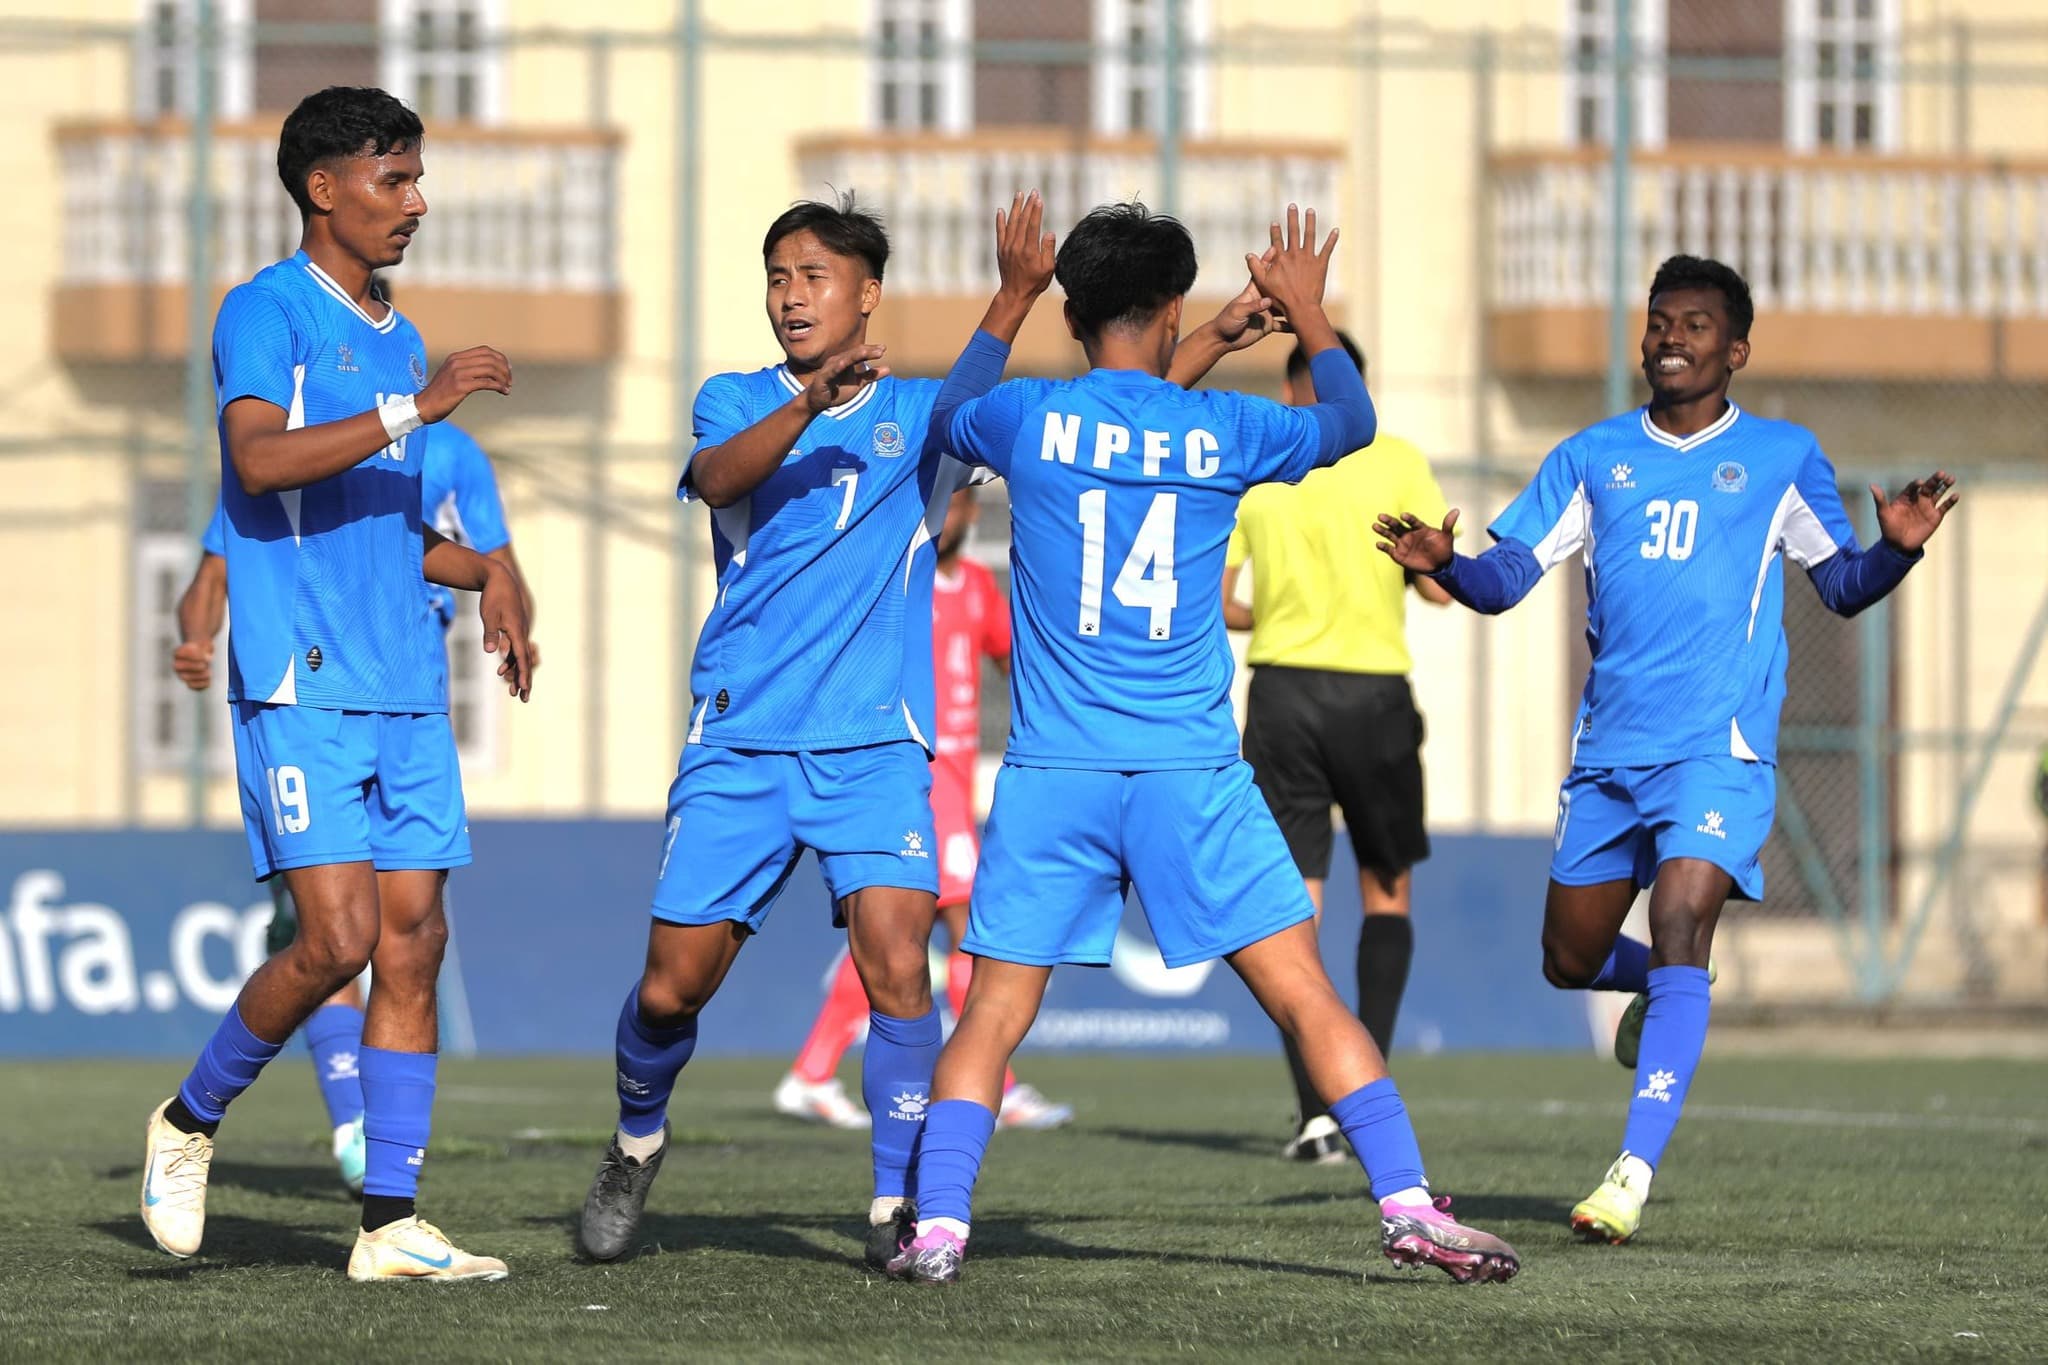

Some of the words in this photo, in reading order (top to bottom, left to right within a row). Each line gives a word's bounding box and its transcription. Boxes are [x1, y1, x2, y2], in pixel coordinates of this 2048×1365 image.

[1040, 411, 1221, 479] NPFC
[831, 467, 859, 530] 7
[1640, 499, 1699, 561] 30
[1078, 489, 1178, 641] 14
[266, 765, 311, 836] 19
[888, 1110, 928, 1121] KELM
